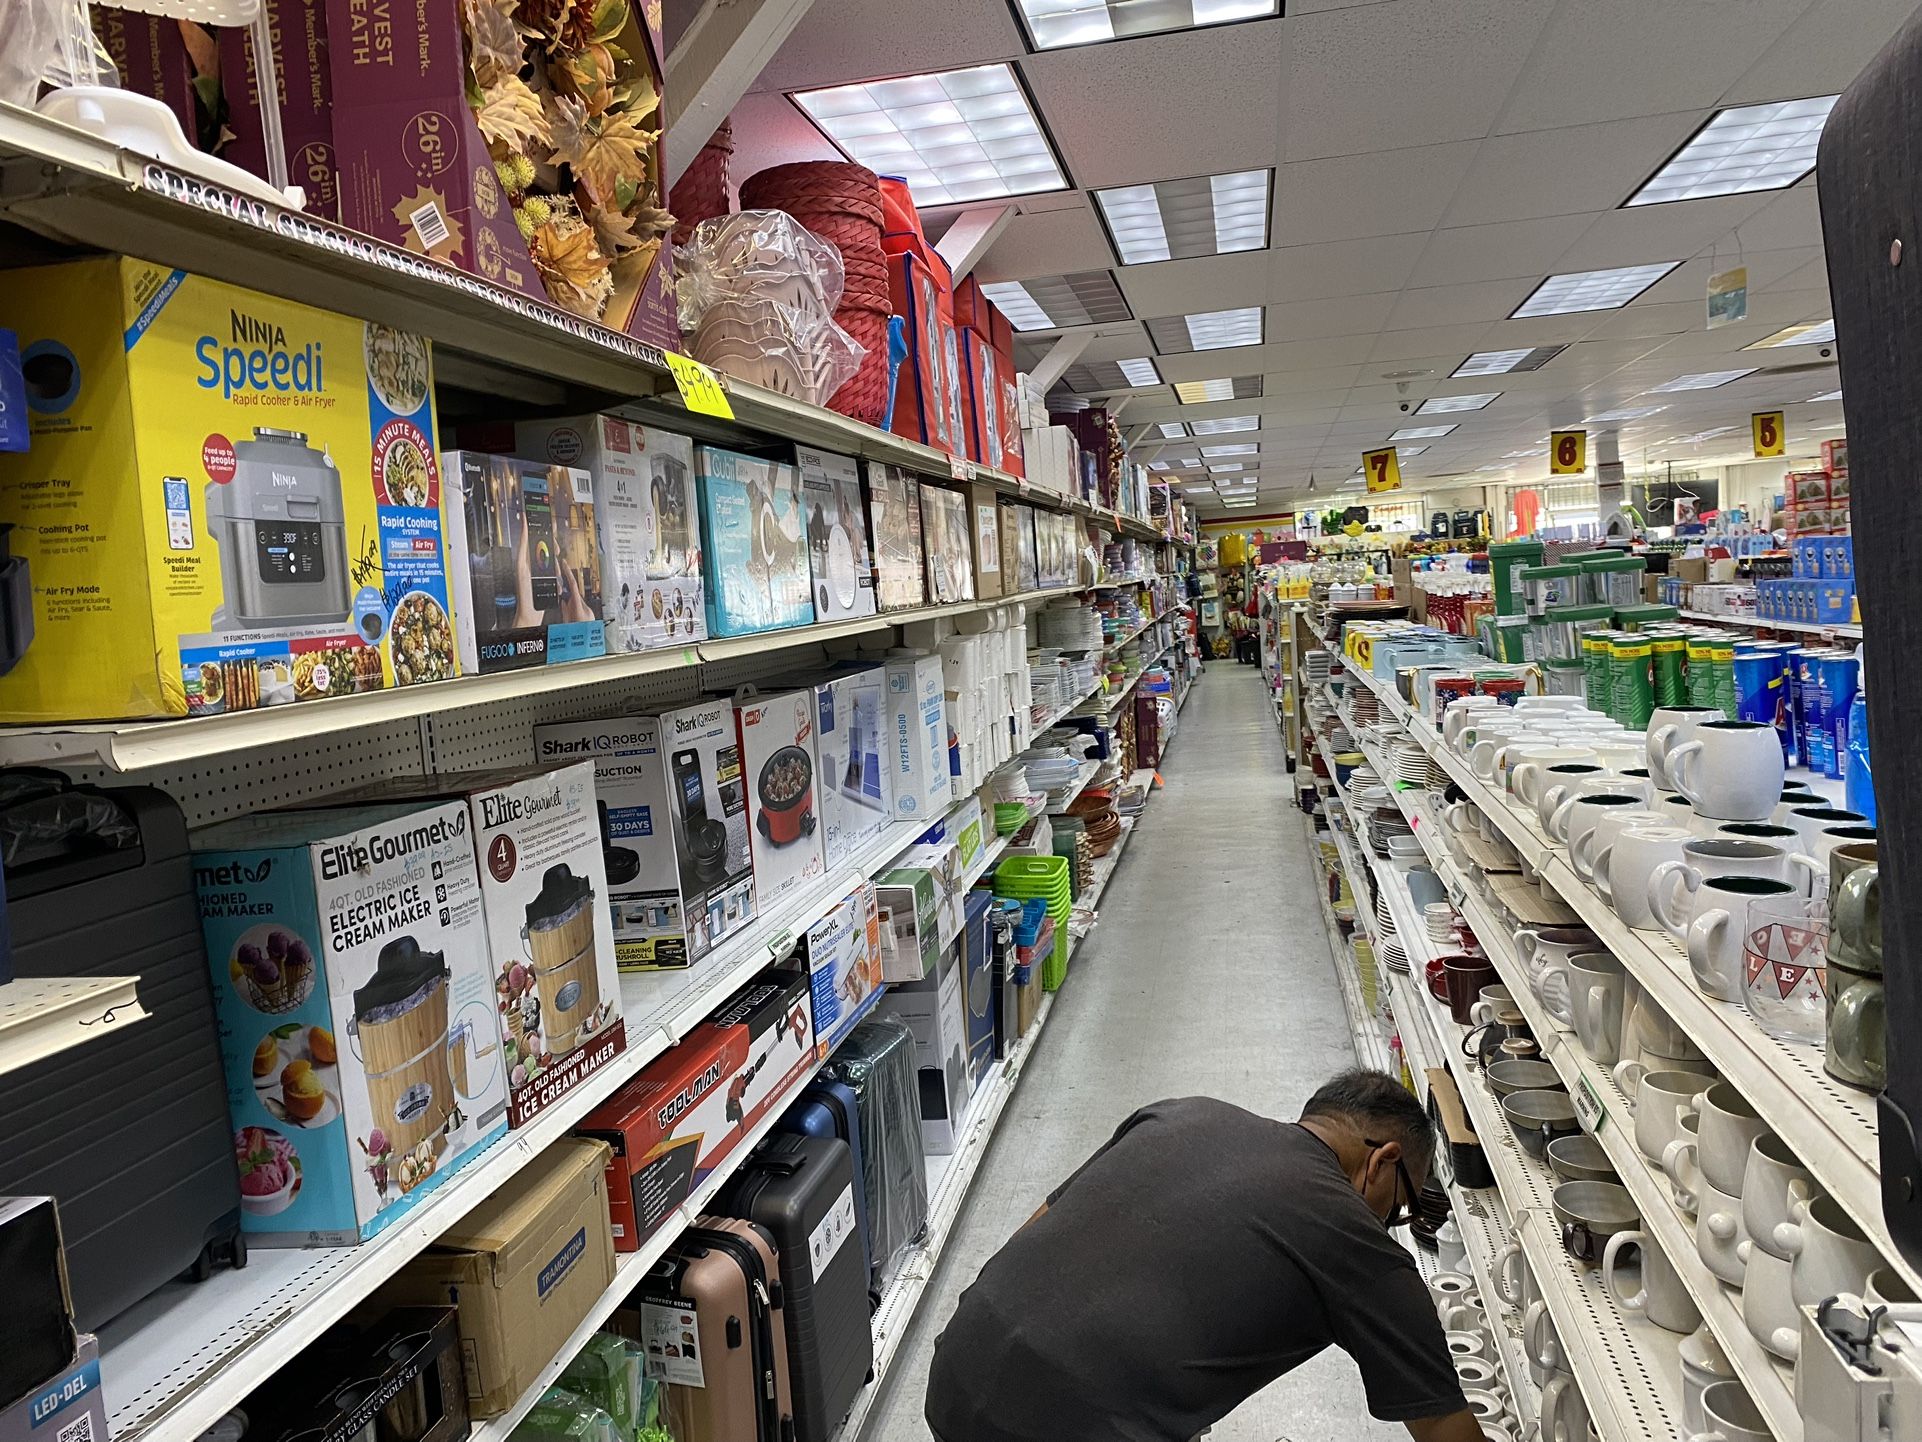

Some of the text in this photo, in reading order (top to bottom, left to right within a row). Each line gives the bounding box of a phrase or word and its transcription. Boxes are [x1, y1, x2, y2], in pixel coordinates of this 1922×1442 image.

[373, 0, 393, 66] VEST
[305, 8, 323, 109] Member's Mark
[418, 34, 431, 70] Mark
[145, 164, 275, 231] SPECIAL
[526, 303, 583, 337] SPECIAL
[586, 325, 638, 358] SPECIAL
[136, 276, 179, 332] #SpeediMeals
[230, 308, 288, 354] NINJA
[195, 336, 323, 400] Speedi
[233, 394, 336, 408] Rapid Cooker & Air Fryer
[1760, 418, 1778, 447] 5
[203, 454, 235, 466] 4 people
[204, 447, 218, 455] Feed
[219, 449, 226, 457] up
[373, 423, 437, 476] 15 MINUTE MEALS
[1558, 436, 1577, 466] 6
[272, 471, 298, 489] NINJA
[1370, 453, 1389, 483] 7
[52, 479, 71, 488] Tray
[38, 524, 89, 534] Cooking Pot
[381, 516, 438, 530] Rapid Cooking
[283, 532, 297, 544] 390F
[390, 541, 434, 550] Steam Air Fry
[163, 556, 185, 565] Speedi
[46, 585, 100, 595] Air Fry Mode
[219, 649, 235, 658] Rapid
[236, 647, 256, 655] Cooker
[334, 639, 347, 647] Fryer
[223, 633, 261, 643] 11 FUNCTIONS
[481, 643, 508, 659] FUGOO
[516, 639, 544, 655] INFERNO
[676, 715, 698, 735] Shark
[704, 710, 721, 724] ROBOT
[542, 731, 655, 756] Shark IQ ROBOT
[595, 765, 643, 778] SUCTION
[478, 786, 562, 831] Elite Gourmet
[611, 820, 650, 831] 30 DAYS
[320, 816, 449, 881] Elite Gourmet
[443, 852, 472, 867] Hand-Crafted
[496, 838, 508, 862] 4
[329, 866, 426, 911] 4QT. OLD FASHIONED
[447, 877, 470, 890] Heavy Duty
[781, 876, 795, 891] SKILLET
[227, 902, 274, 917] MAKER
[329, 884, 421, 934] ELECTRIC ICE
[450, 901, 469, 913] Powerful
[332, 918, 386, 953] CREAM
[388, 899, 432, 932] MAKER
[811, 919, 838, 946] PowerXL
[616, 946, 652, 955] -CLEANING
[811, 946, 822, 960] DUO
[1749, 956, 1795, 983] L E
[517, 1048, 586, 1103] 4QT. OLD FASHIONED
[518, 1041, 615, 1123] ICE CREAM MAKER
[770, 1078, 787, 1100] CORDLESS
[787, 1065, 799, 1082] STRING
[657, 1059, 720, 1129] TOOLMAN
[541, 1236, 583, 1287] TRAMONTINA
[645, 1295, 693, 1309] GEOFFREY BEENE
[347, 1364, 418, 1436] GLASS CANDLE SET
